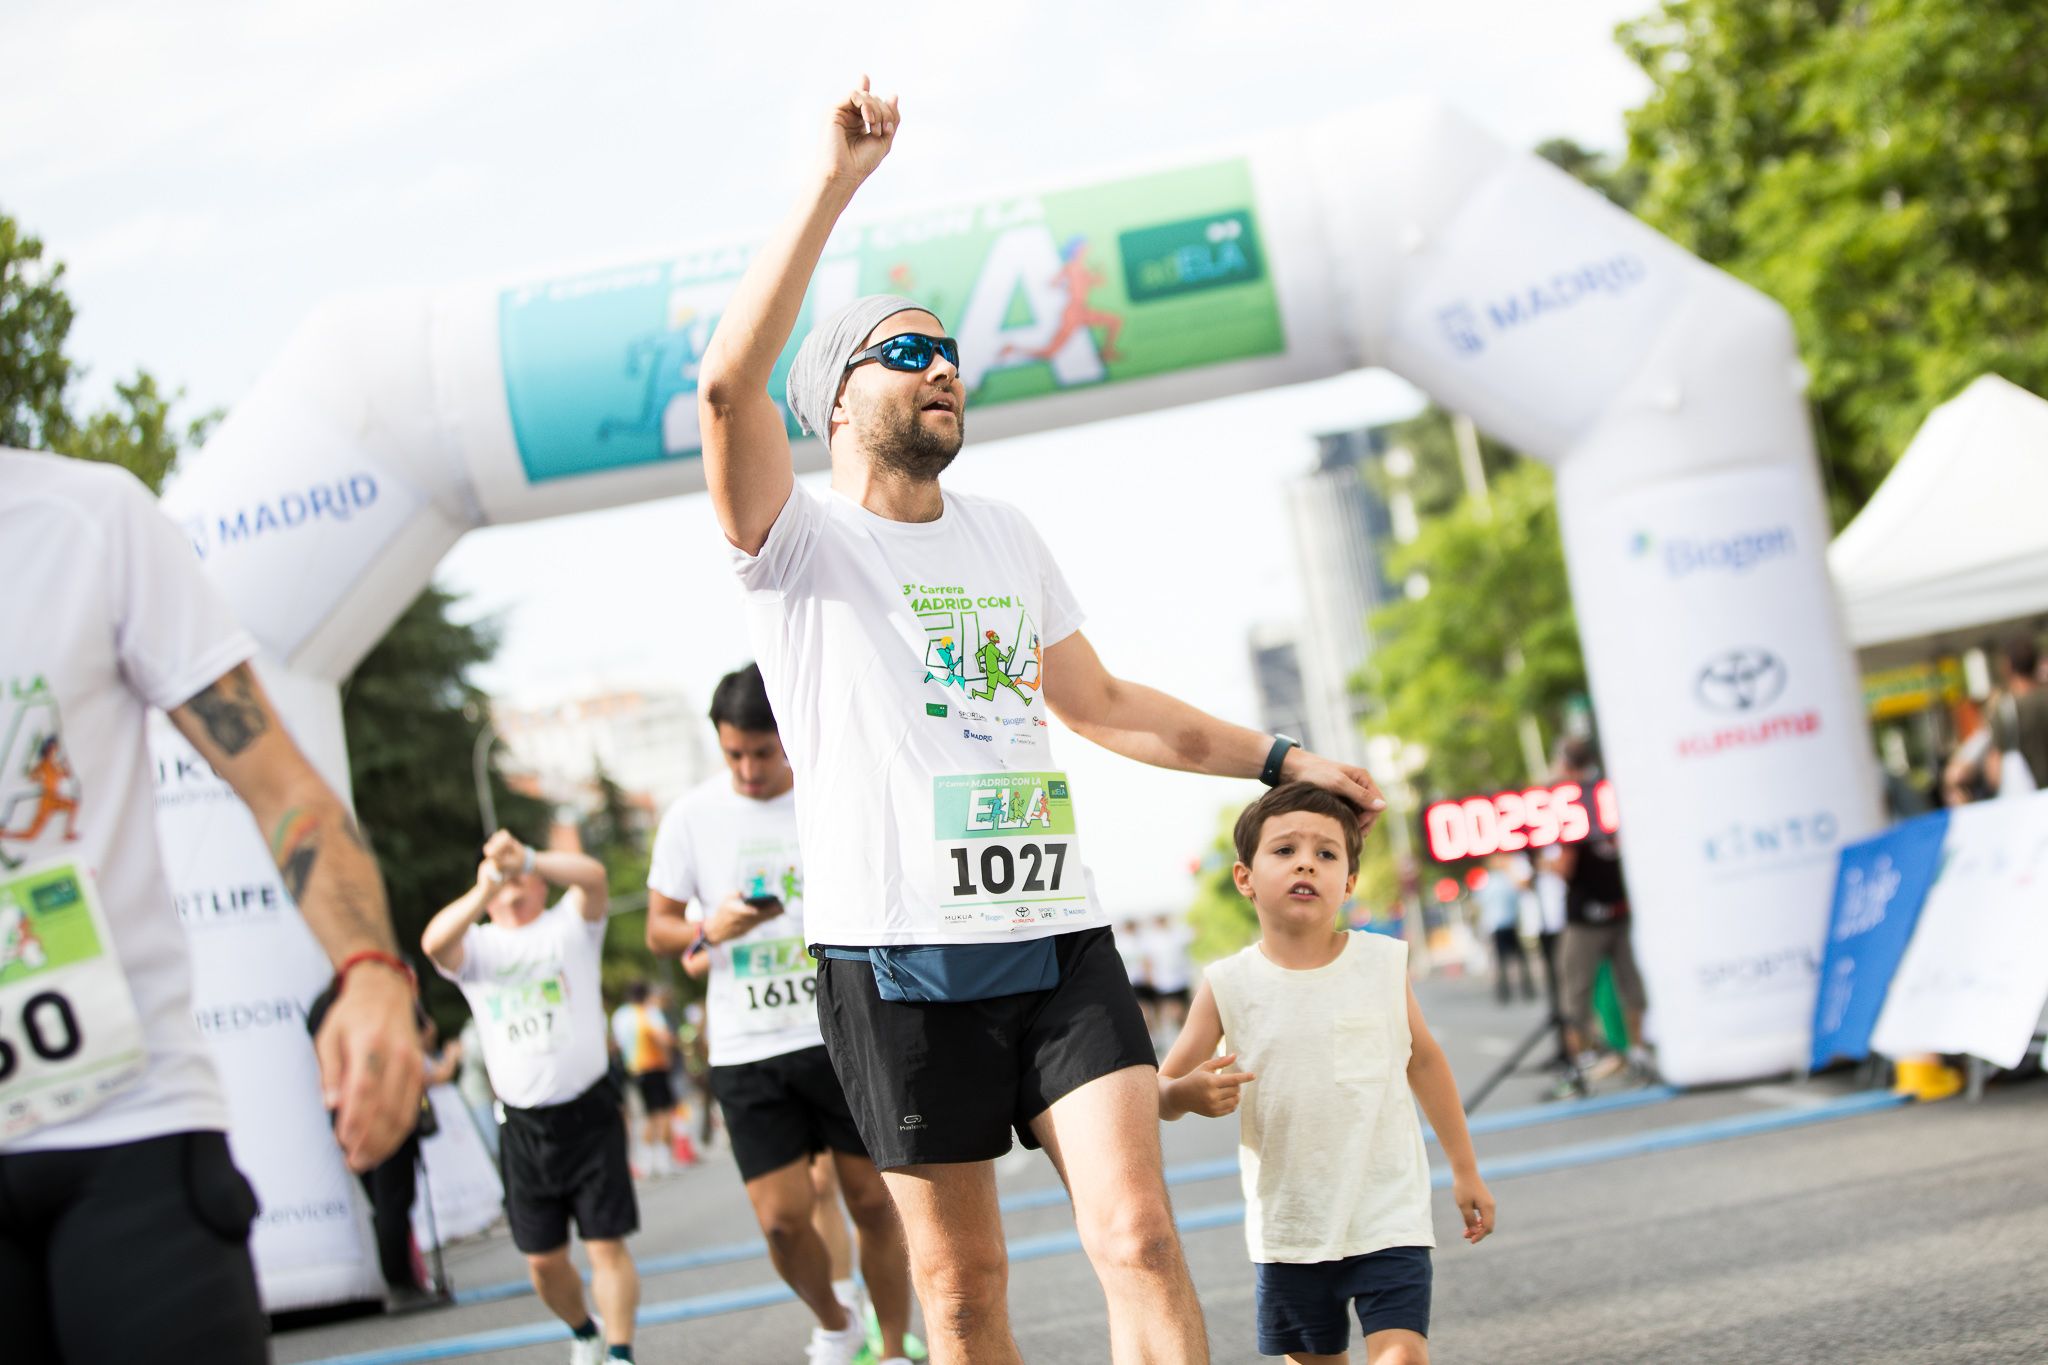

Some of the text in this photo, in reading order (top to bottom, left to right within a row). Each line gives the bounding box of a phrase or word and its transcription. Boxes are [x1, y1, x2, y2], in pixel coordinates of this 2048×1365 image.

[1488, 252, 1646, 330] MADRID
[219, 473, 379, 541] MADRID
[1664, 526, 1797, 578] Biogen
[919, 584, 965, 595] Carrera
[977, 596, 1012, 609] CON
[970, 732, 992, 743] MADRID
[971, 777, 1010, 788] MADRID
[1011, 777, 1030, 786] CON
[1031, 777, 1042, 785] LA
[966, 787, 1051, 831] ELA
[950, 843, 1067, 896] 1027
[748, 976, 816, 1009] 1619
